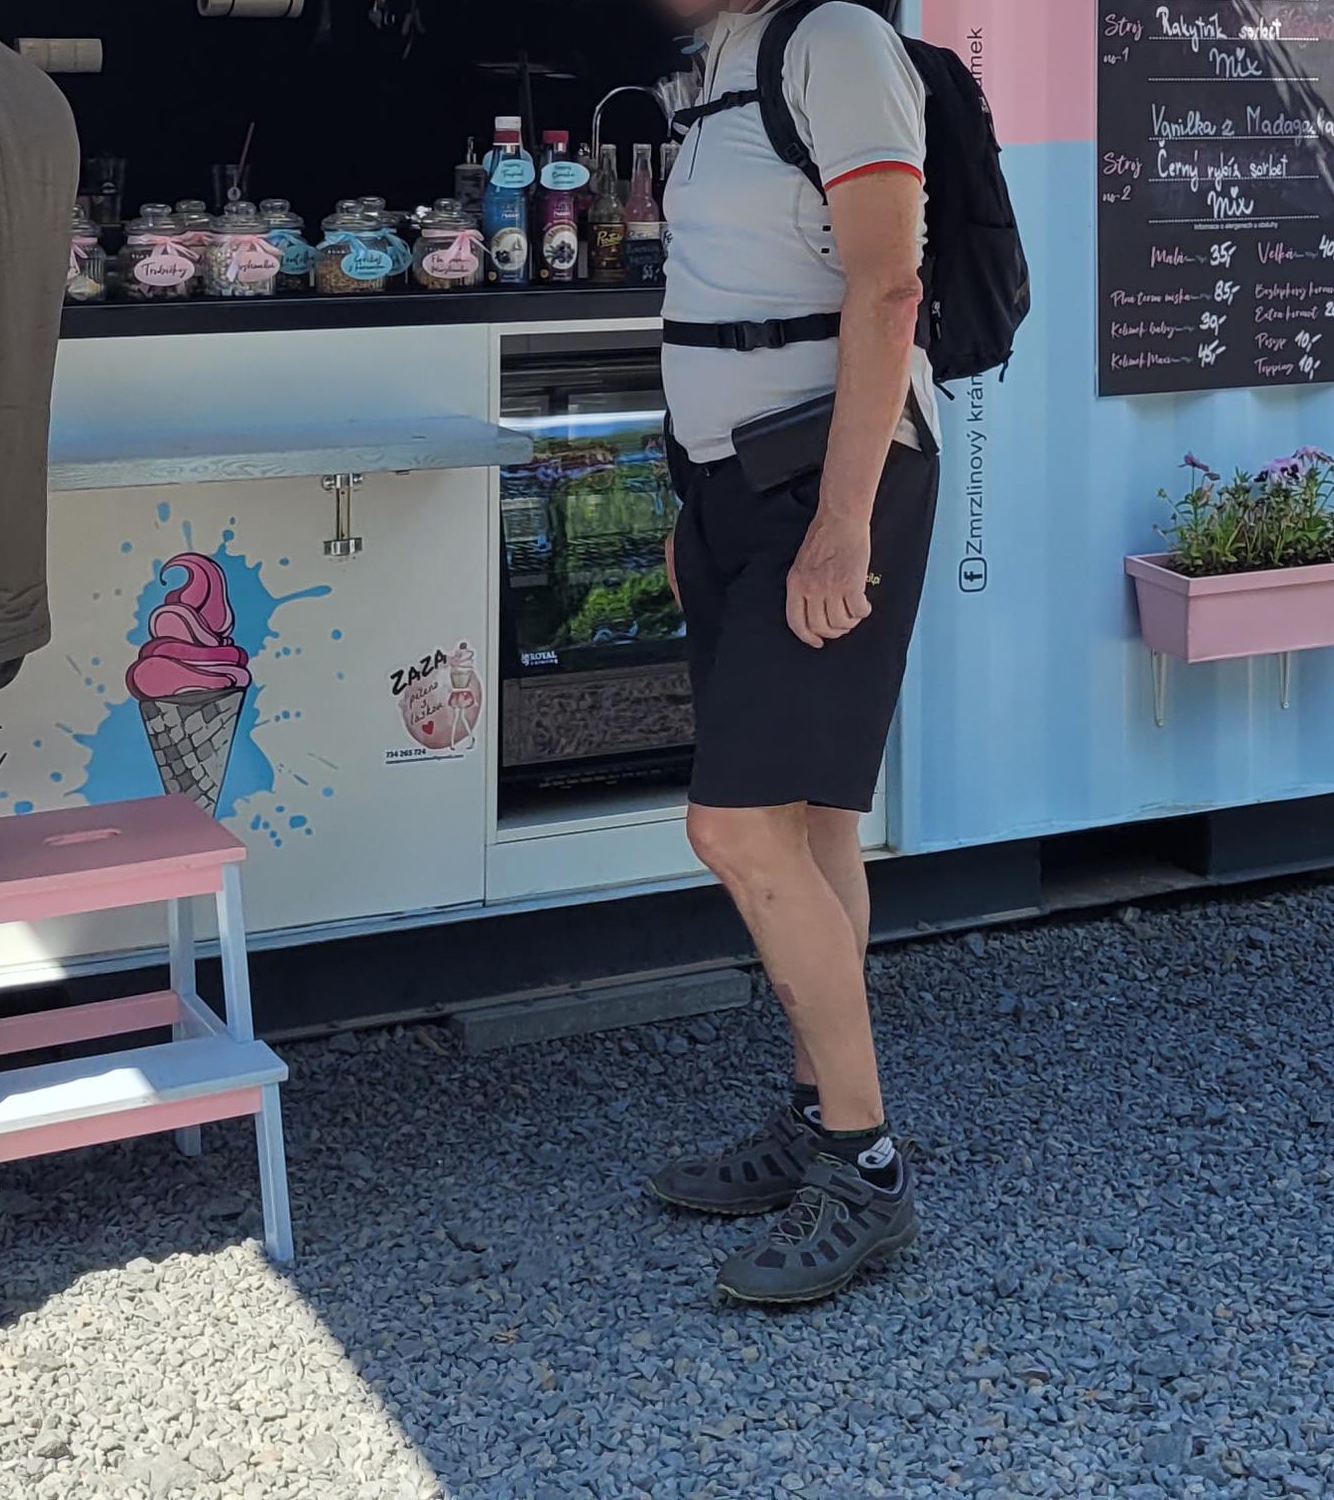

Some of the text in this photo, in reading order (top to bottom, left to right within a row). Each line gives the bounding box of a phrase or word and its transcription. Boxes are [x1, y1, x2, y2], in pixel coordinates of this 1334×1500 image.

[1249, 153, 1289, 179] sorbet
[966, 429, 987, 555] Zmrzlinový
[389, 649, 448, 696] ZAZA
